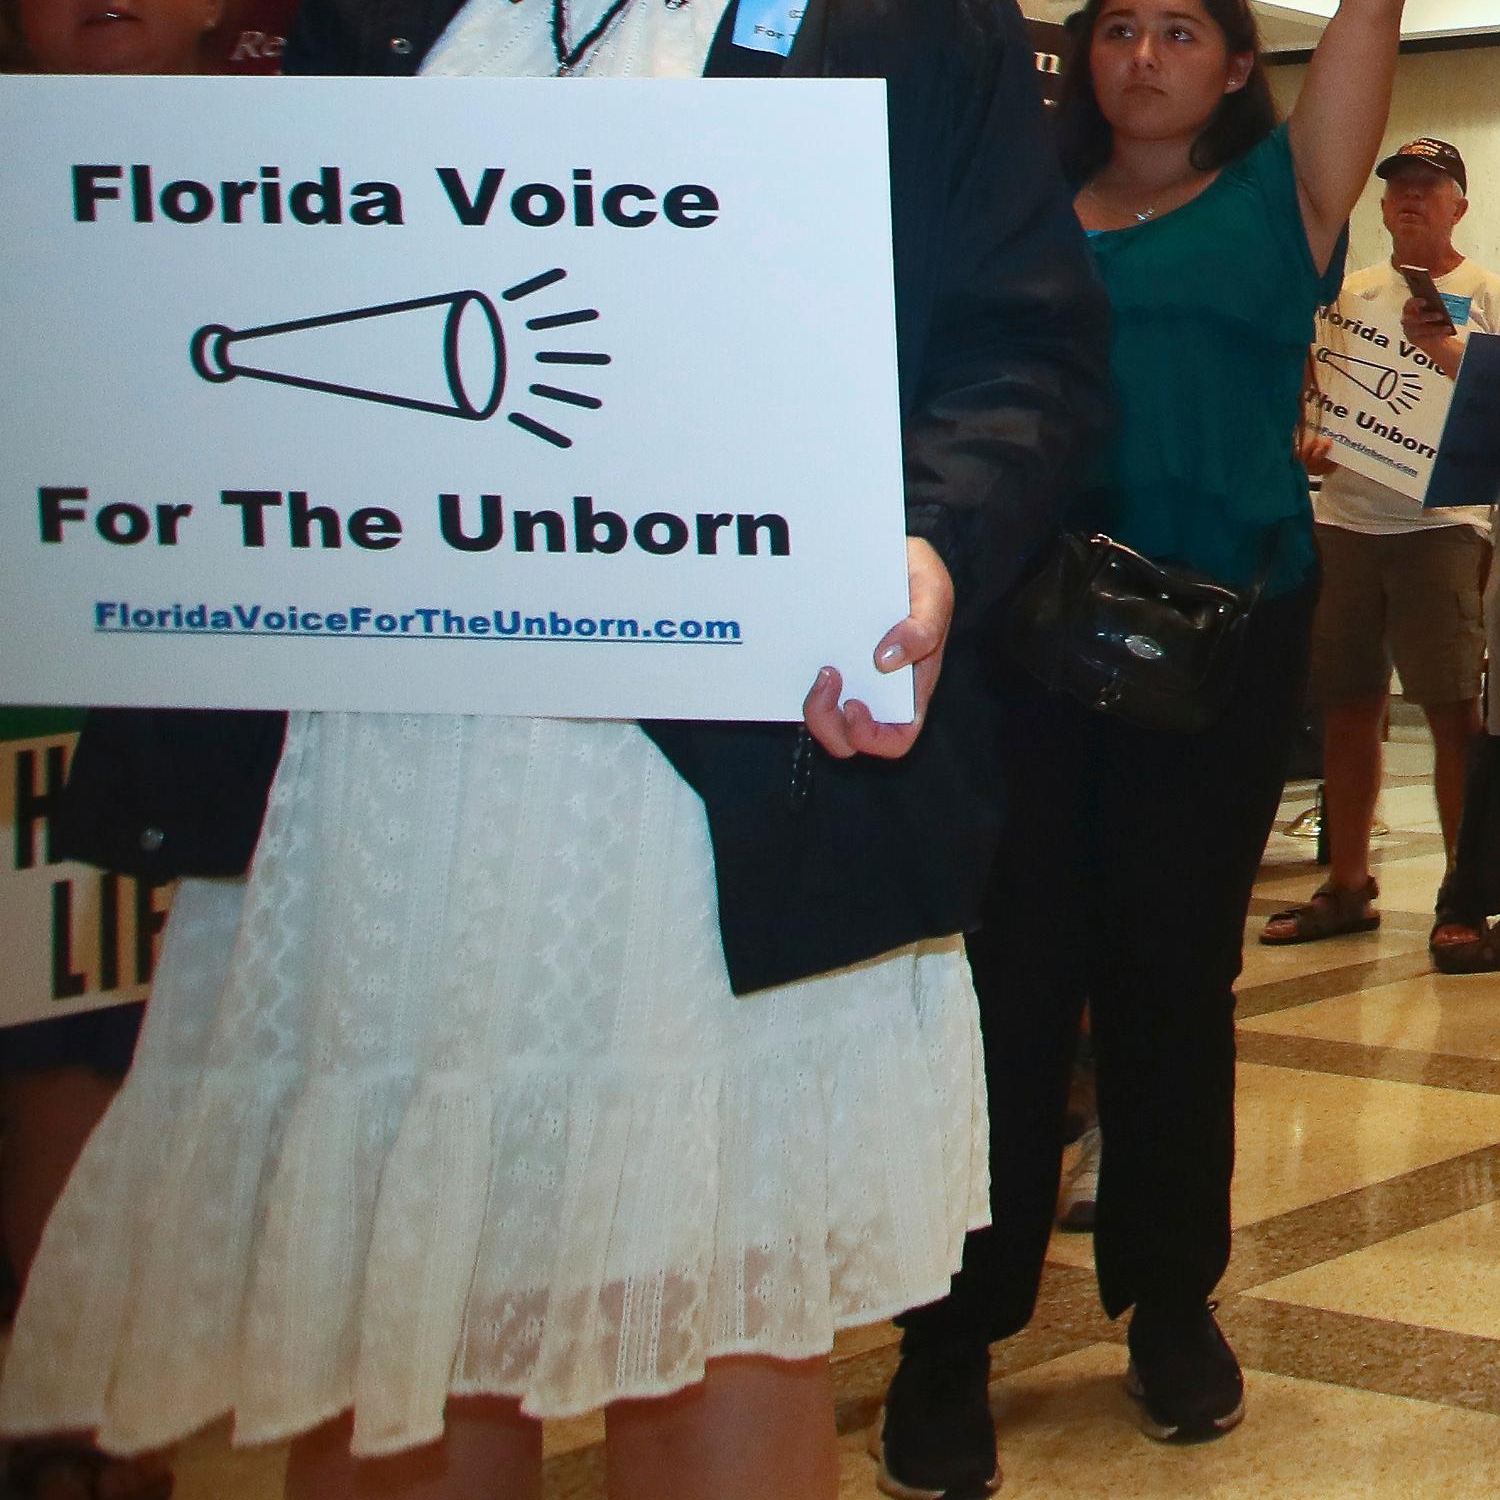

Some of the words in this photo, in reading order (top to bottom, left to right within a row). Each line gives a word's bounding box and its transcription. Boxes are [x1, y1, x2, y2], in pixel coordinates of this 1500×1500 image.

[71, 164, 405, 228] Florida
[436, 167, 721, 229] Voice
[37, 487, 194, 546] For
[221, 491, 404, 551] The
[439, 494, 793, 558] Unborn
[94, 602, 744, 645] FloridaVoiceForTheUnborn.com
